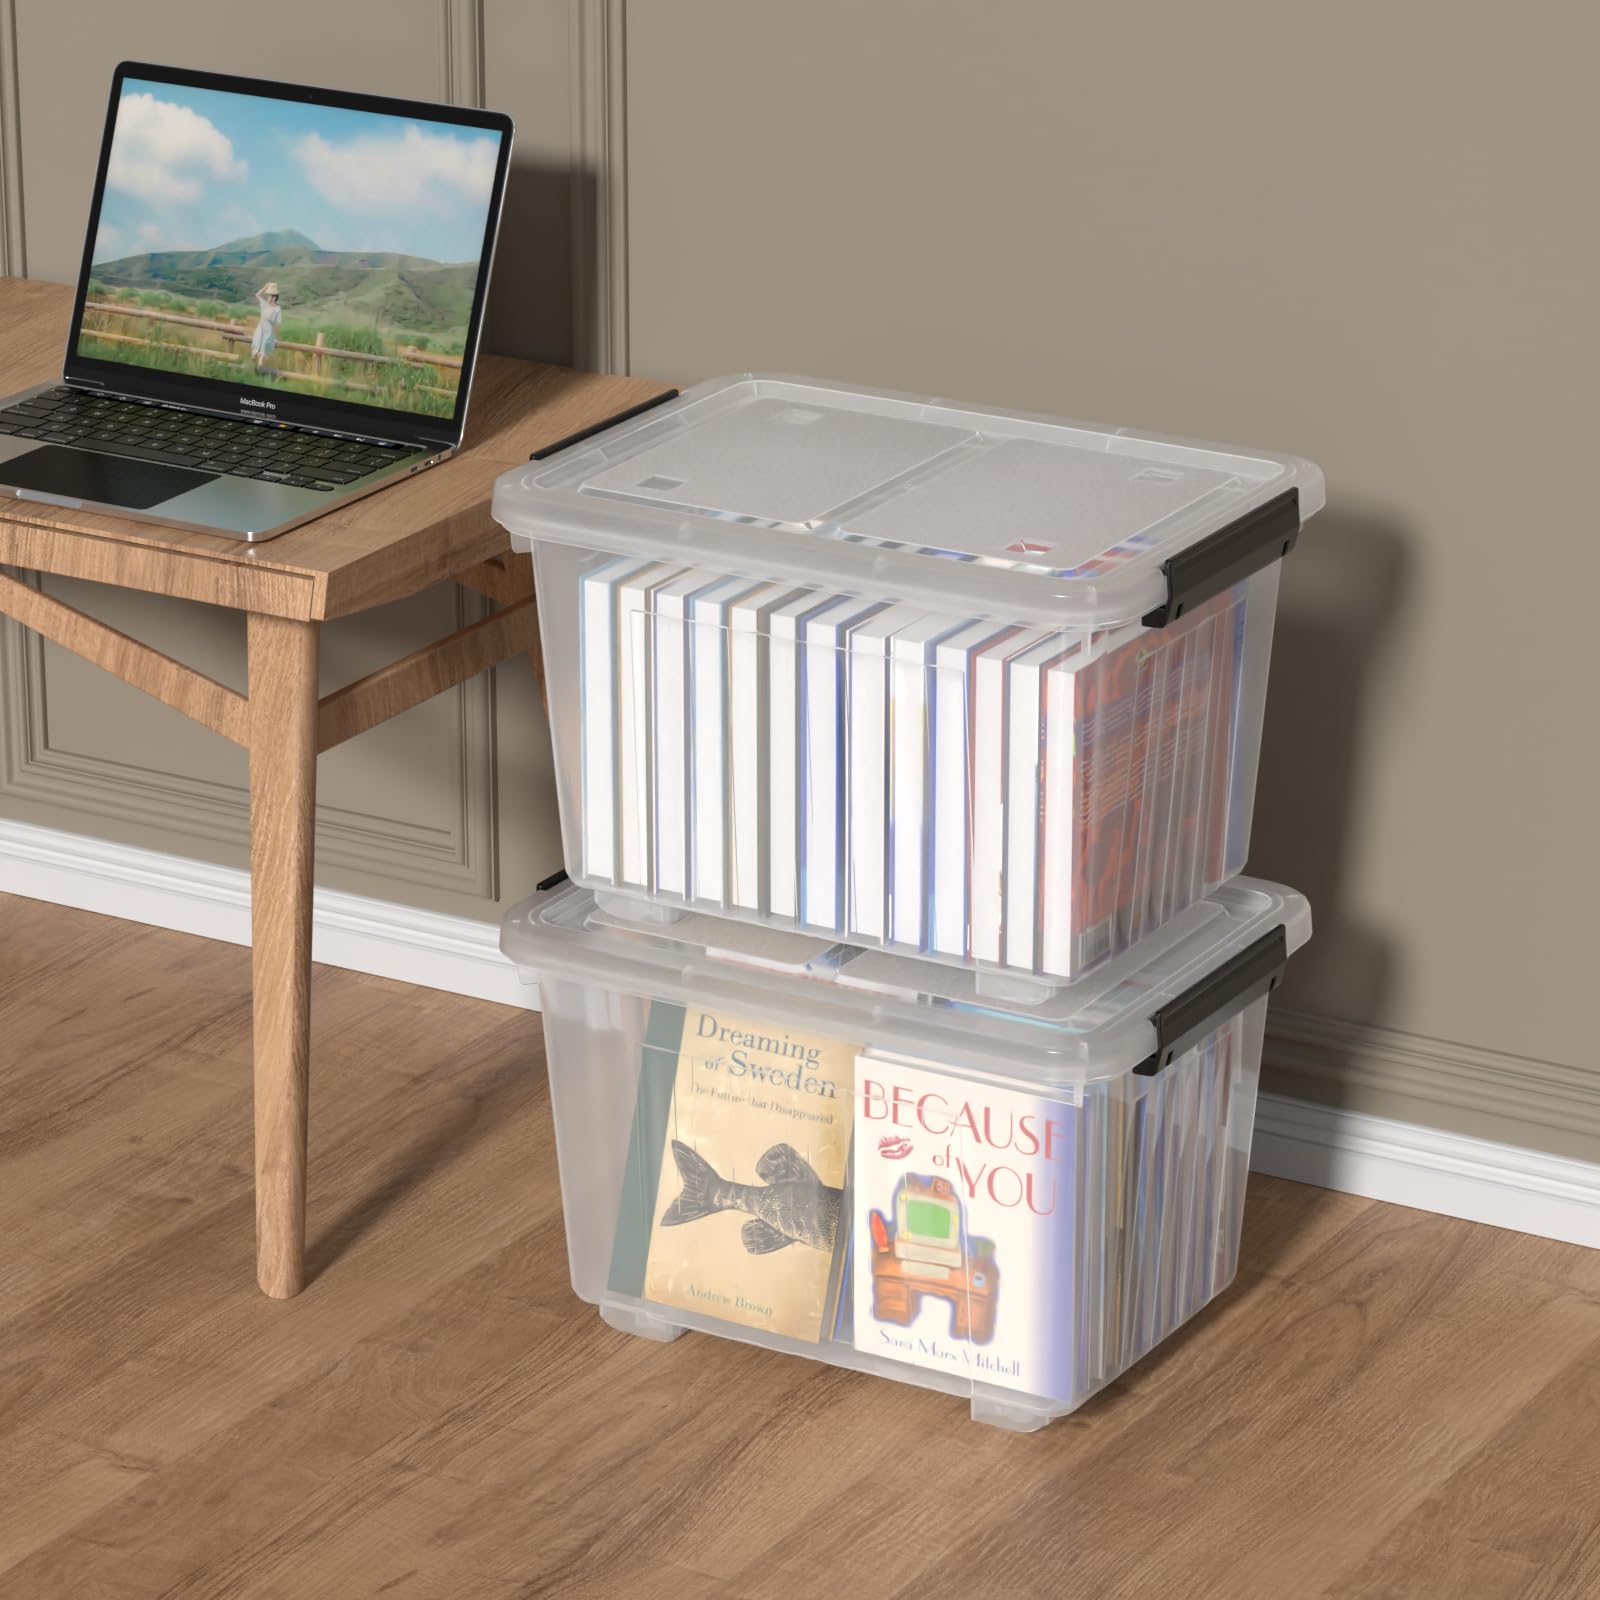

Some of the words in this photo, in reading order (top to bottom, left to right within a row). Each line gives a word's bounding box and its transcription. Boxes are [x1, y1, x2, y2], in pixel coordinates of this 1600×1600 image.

[239, 397, 266, 408] MacBook
[266, 401, 277, 410] Pro
[696, 1013, 823, 1071] Dreaming
[727, 1050, 838, 1099] Sweden
[863, 1079, 1066, 1161] BECAUSE
[932, 1143, 954, 1169] of
[955, 1156, 1057, 1217] YOU
[687, 1284, 732, 1305] Andrew
[735, 1295, 774, 1316] Brown
